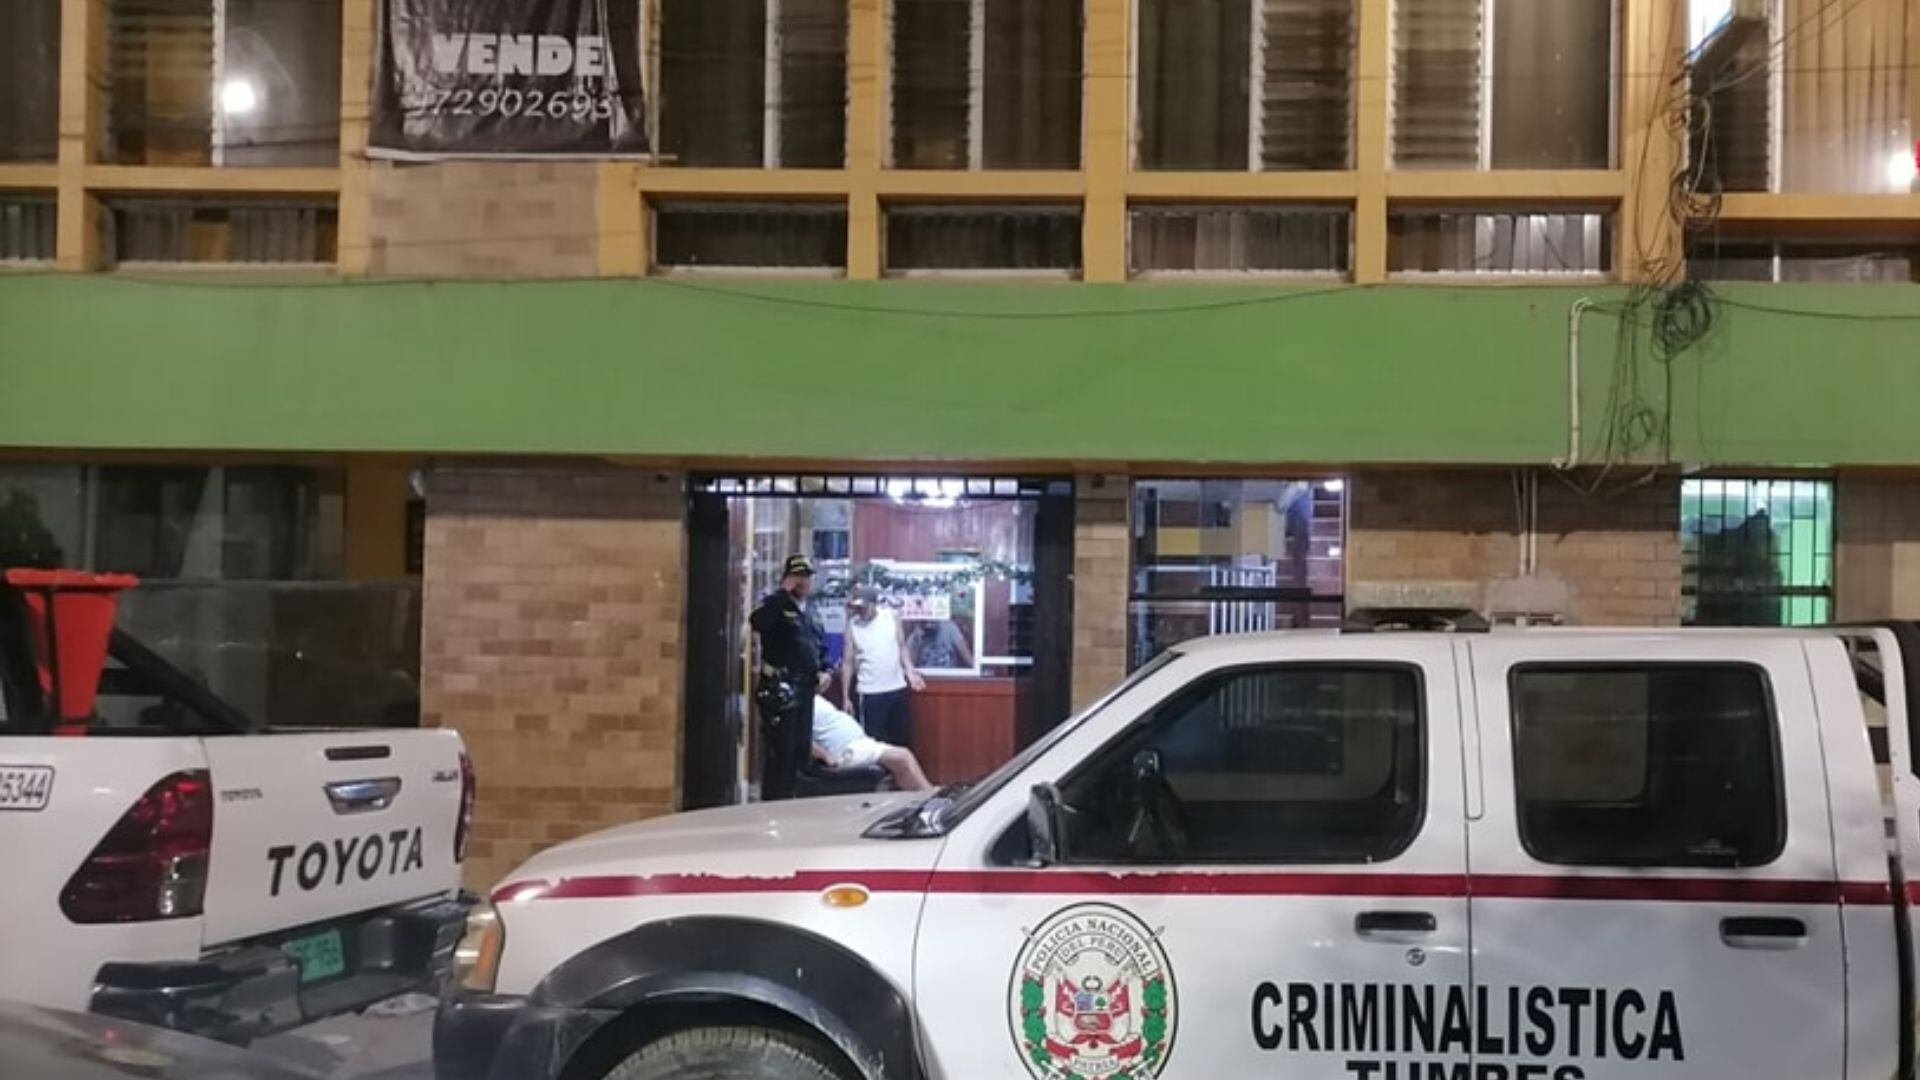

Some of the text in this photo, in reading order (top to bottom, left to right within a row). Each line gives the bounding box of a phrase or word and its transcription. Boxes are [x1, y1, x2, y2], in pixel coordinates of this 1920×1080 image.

[432, 32, 604, 76] VENDE
[0, 771, 49, 804] 5344
[267, 826, 424, 897] TOYOTA
[1061, 938, 1084, 957] DEL
[1088, 919, 1152, 971] NACIONAL
[1251, 981, 1685, 1061] CRIMINALISTICA
